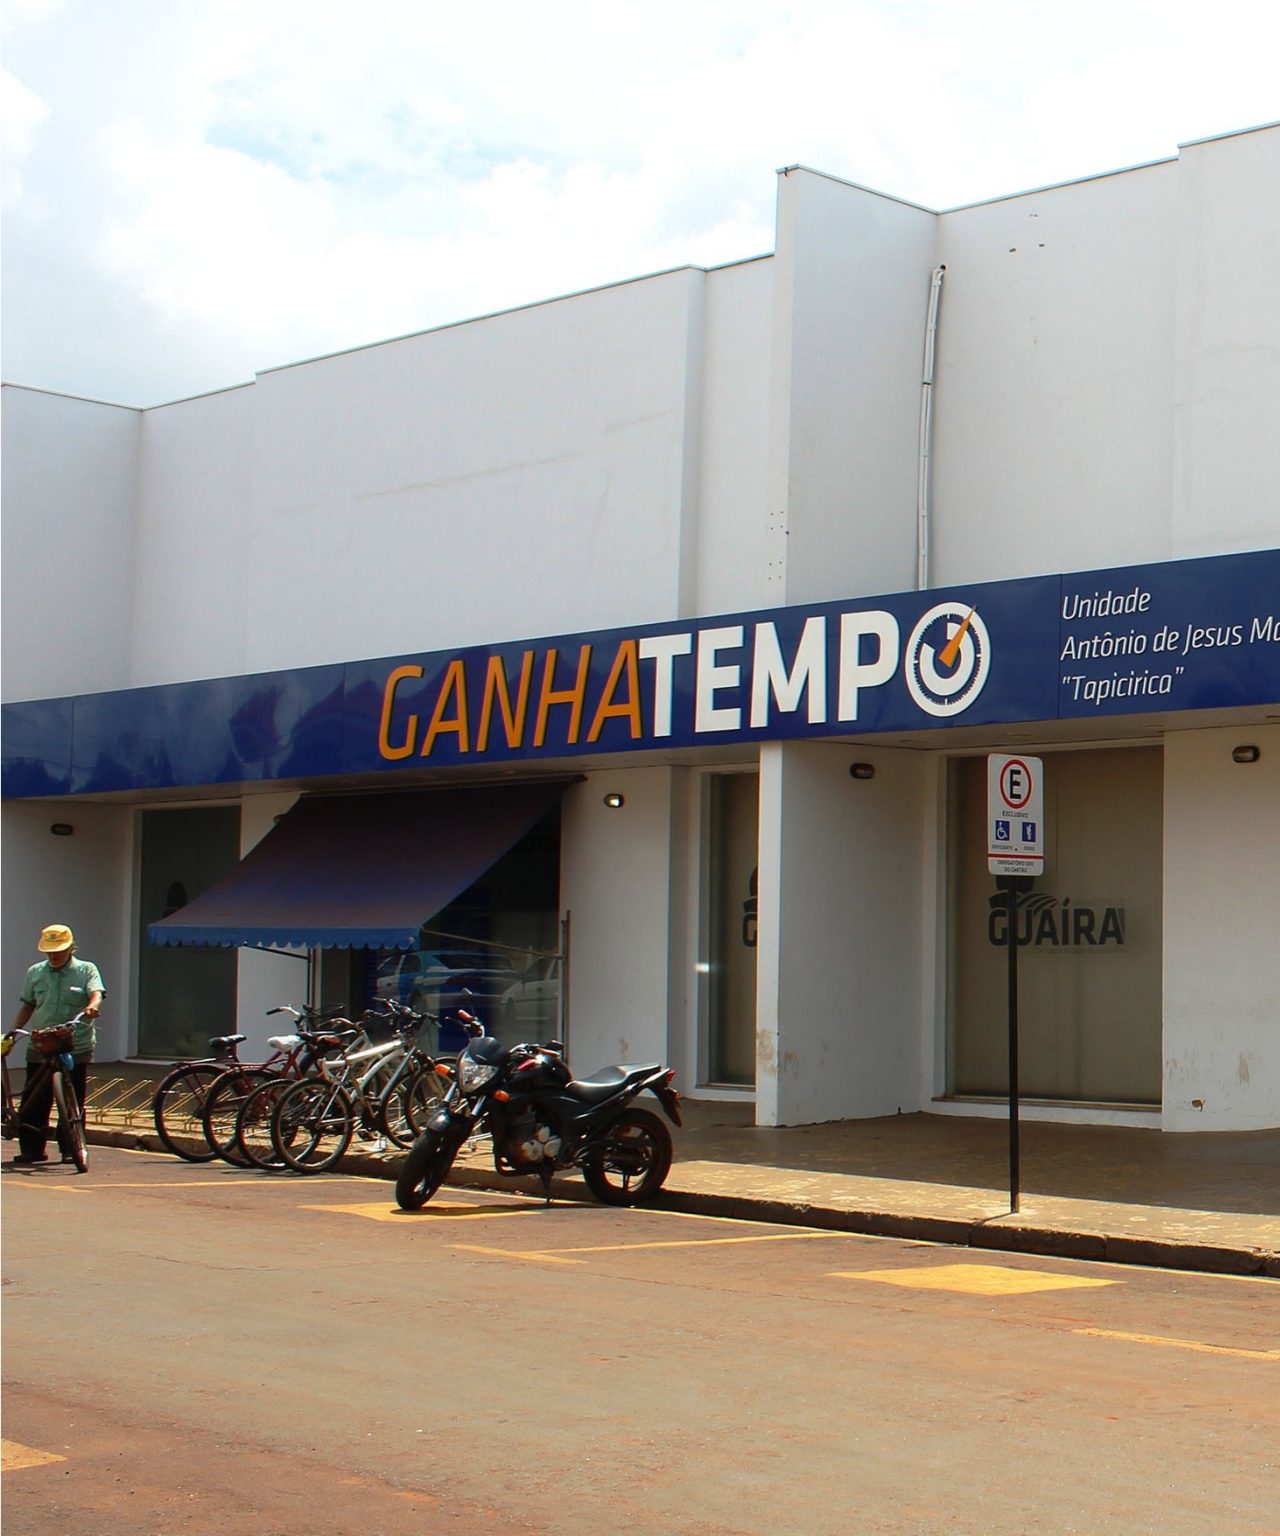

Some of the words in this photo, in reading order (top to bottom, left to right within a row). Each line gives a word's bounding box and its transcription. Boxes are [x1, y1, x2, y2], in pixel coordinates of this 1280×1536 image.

[1062, 587, 1151, 620] Unidade
[1060, 630, 1147, 660] Antônio
[1153, 626, 1179, 653] de
[1182, 624, 1243, 655] Jesus
[1009, 768, 1022, 800] E
[989, 897, 1123, 946] GUAÍRA
